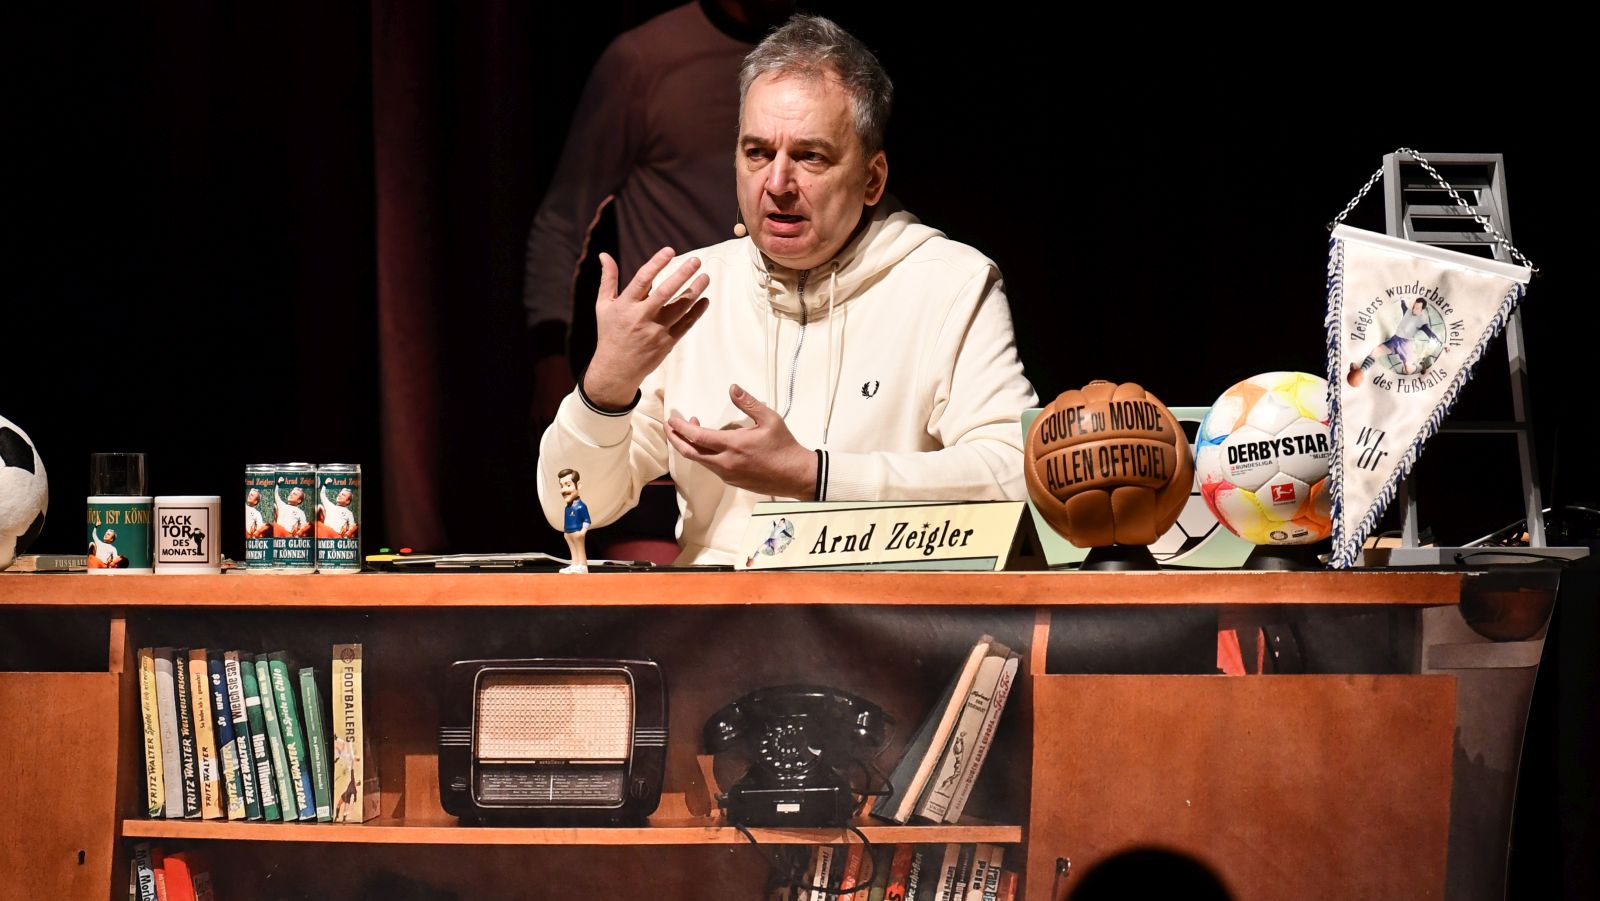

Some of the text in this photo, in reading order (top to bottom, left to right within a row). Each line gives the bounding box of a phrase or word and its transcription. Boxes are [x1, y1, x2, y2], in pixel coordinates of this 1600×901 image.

[1350, 280, 1465, 347] Zeiglers wunderbare Welt
[1372, 367, 1448, 394] des Fußballs
[1040, 400, 1164, 445] COUPE DU MONDE
[1227, 433, 1329, 465] DERBYSTAR
[1046, 445, 1168, 491] ALLEN OFFICIEL
[1235, 460, 1273, 470] BUNDESLIGA
[105, 509, 120, 525] IST
[124, 507, 152, 525] KÖNN
[161, 515, 192, 526] KACK
[161, 525, 192, 540] TOR
[172, 539, 190, 547] DES
[248, 538, 269, 549] GLÜCK
[288, 538, 311, 548] GLÜCK
[809, 520, 975, 556] Arnd Zeigler
[161, 548, 197, 556] MONATS
[279, 549, 309, 561] KÖNNEN!
[327, 549, 357, 561] KÖNNEN!
[212, 673, 221, 686] es
[229, 678, 238, 690] sie
[272, 668, 285, 692] Chile
[215, 692, 223, 710] war
[231, 691, 240, 704] ich
[344, 666, 355, 743] FOOTBALLERS
[218, 717, 226, 727] So
[233, 705, 243, 719] Wie
[281, 703, 293, 727] Spiele
[147, 738, 157, 775] WALTER
[182, 738, 195, 780] WALTER
[202, 746, 210, 782] WALTER
[237, 735, 250, 774] WALTER
[287, 742, 302, 779] WALTER
[252, 733, 275, 807] Hans Tilkowski
[148, 776, 158, 806] FRITZ
[187, 781, 197, 811] FRITZ
[203, 780, 211, 807] FRITZ
[242, 773, 255, 805] FRITZ
[293, 779, 308, 811] FRITZ
